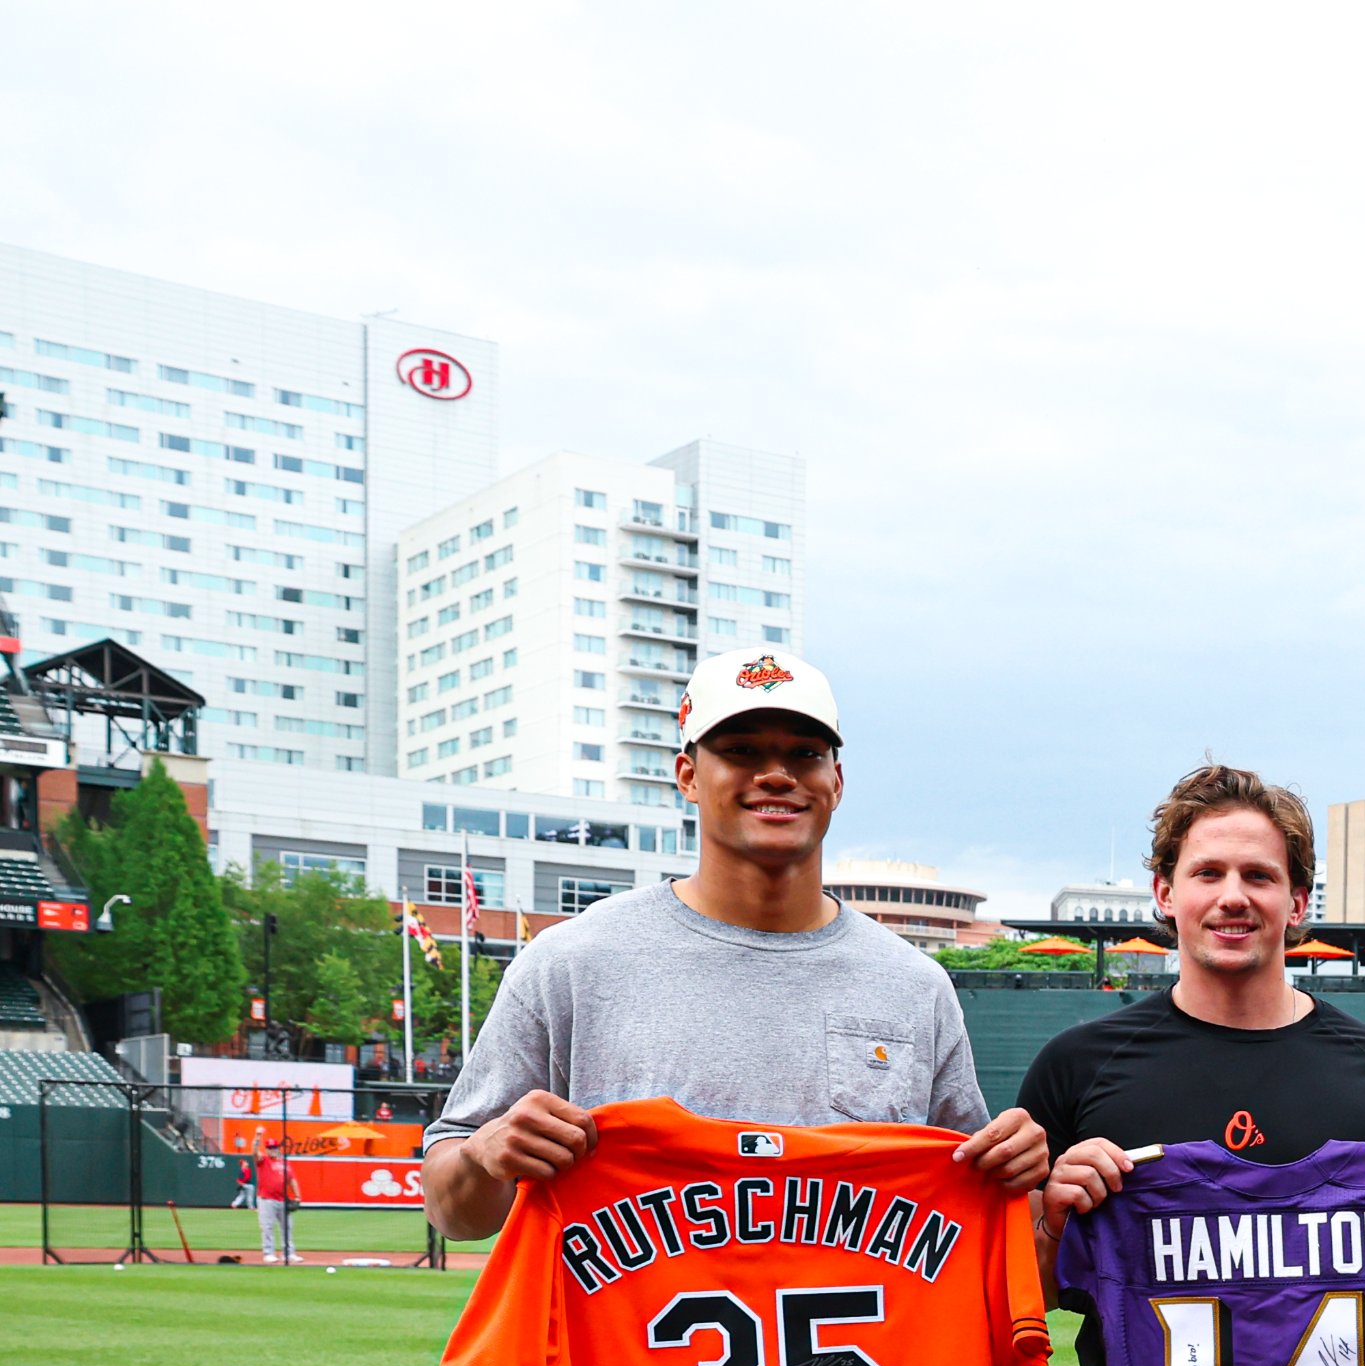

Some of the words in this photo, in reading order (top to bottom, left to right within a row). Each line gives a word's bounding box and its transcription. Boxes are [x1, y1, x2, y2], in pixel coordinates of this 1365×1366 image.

[1224, 1110, 1265, 1151] O's
[197, 1156, 225, 1169] 376
[561, 1176, 962, 1295] RUTSCHMAN
